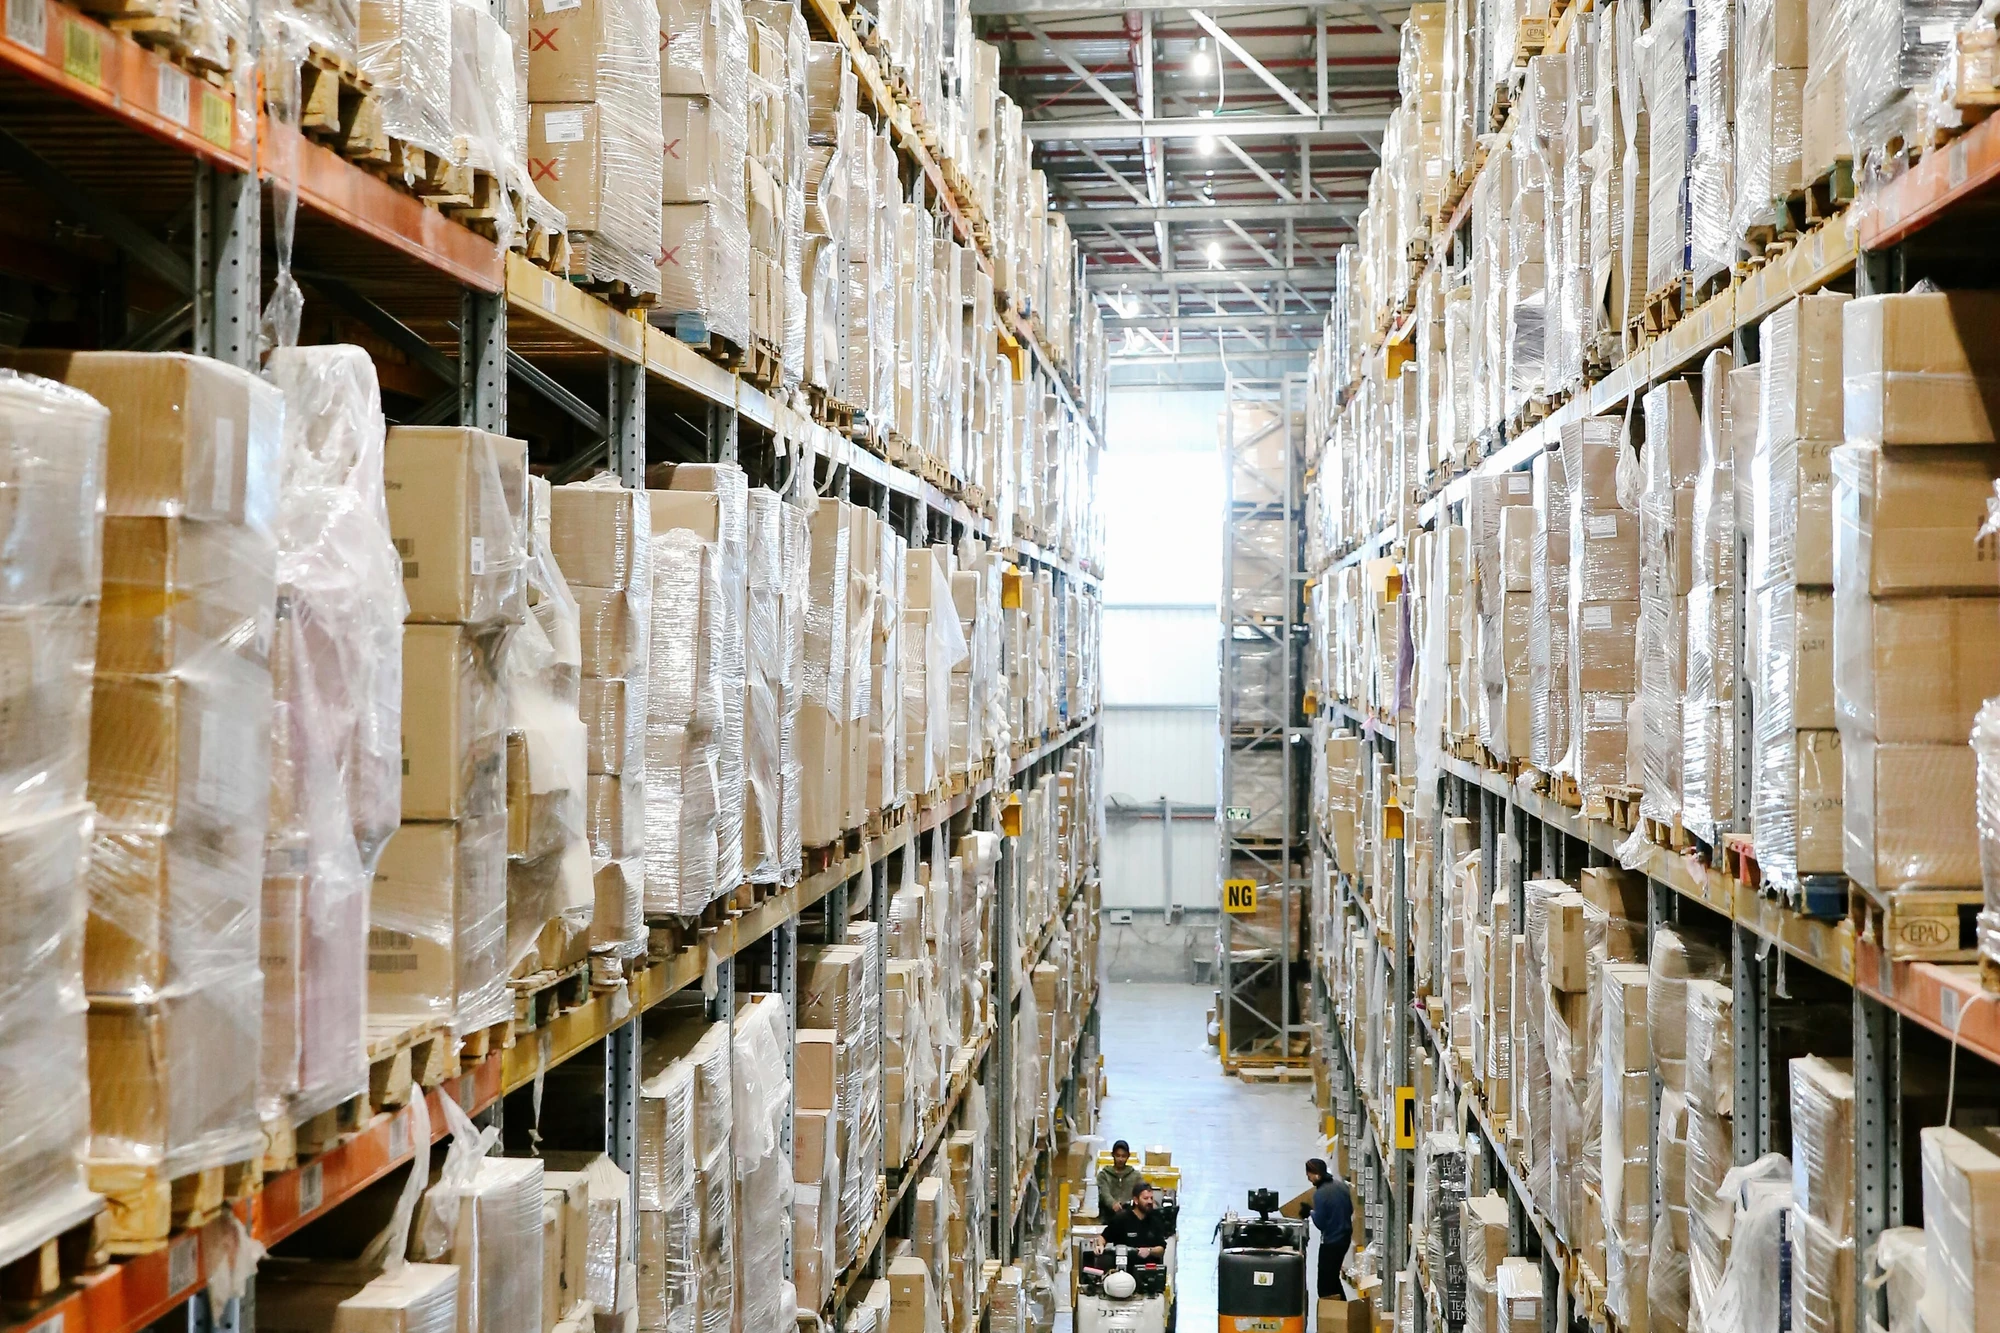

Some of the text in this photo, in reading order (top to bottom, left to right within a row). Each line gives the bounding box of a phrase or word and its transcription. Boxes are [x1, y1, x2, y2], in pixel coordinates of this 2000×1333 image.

[1228, 886, 1252, 906] NG
[1910, 924, 1943, 941] EPAL
[1451, 1301, 1466, 1311] TEA
[1451, 1311, 1467, 1321] TIM
